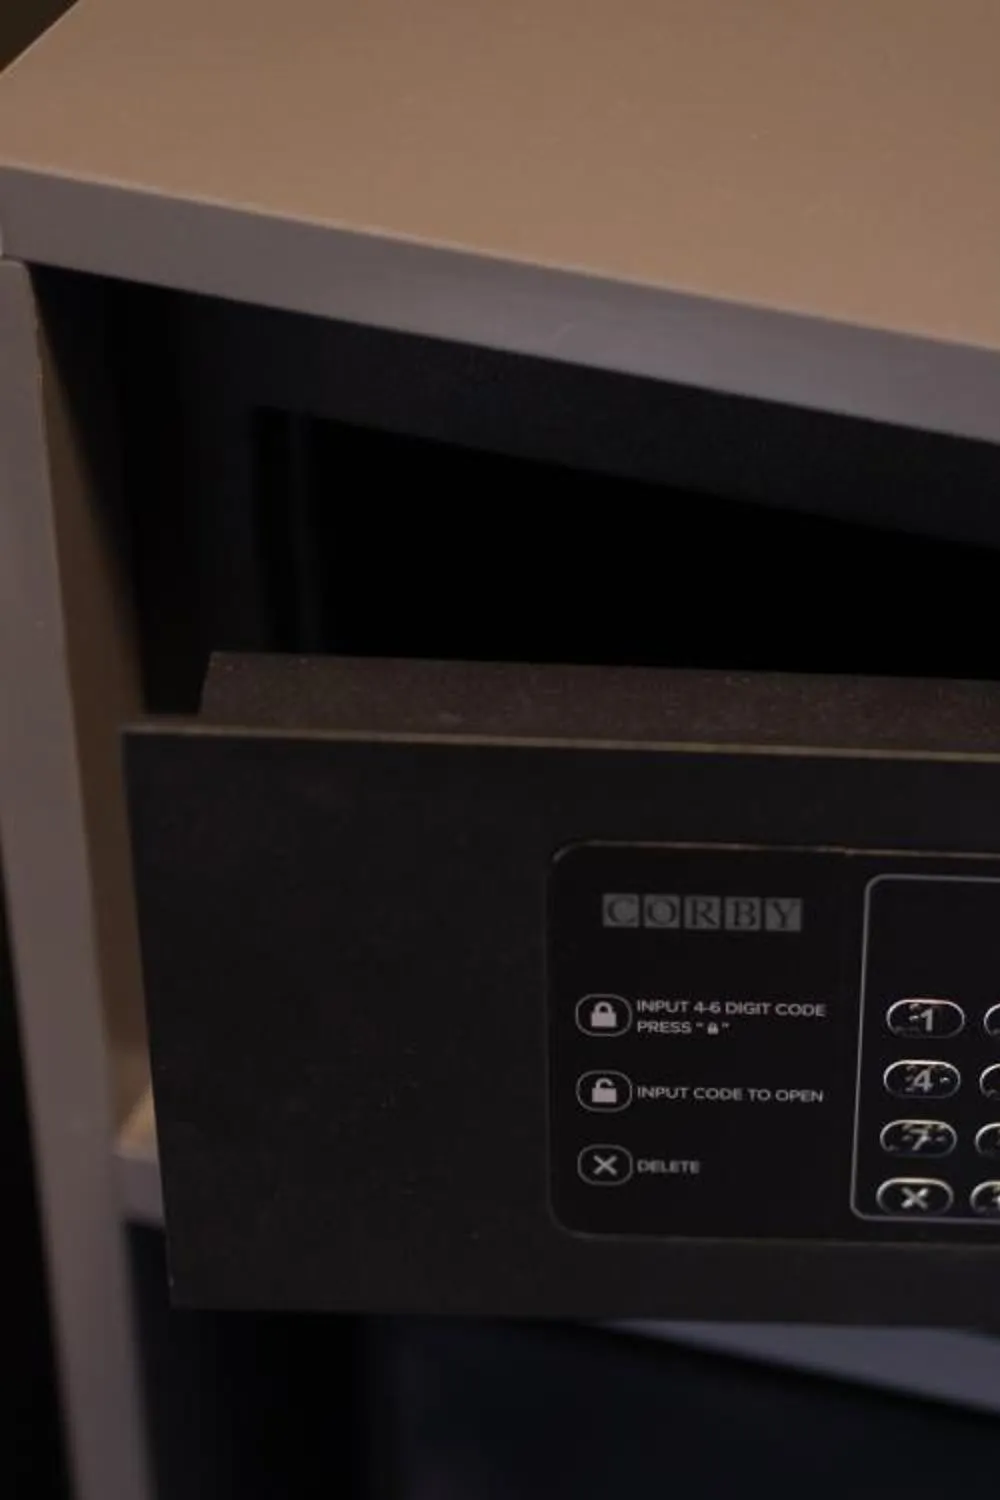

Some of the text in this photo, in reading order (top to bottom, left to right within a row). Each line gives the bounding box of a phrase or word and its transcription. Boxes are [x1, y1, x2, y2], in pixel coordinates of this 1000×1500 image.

[603, 894, 801, 931] CORBY
[637, 999, 826, 1017] INPUT 4-6 DIGIT CODE
[637, 1021, 692, 1034] PRESS
[920, 1008, 934, 1032] 1
[911, 1068, 933, 1091] 4
[637, 1086, 823, 1102] INPUT CODE TO OPEN
[911, 1128, 930, 1151] 7
[637, 1160, 700, 1173] DELETE
